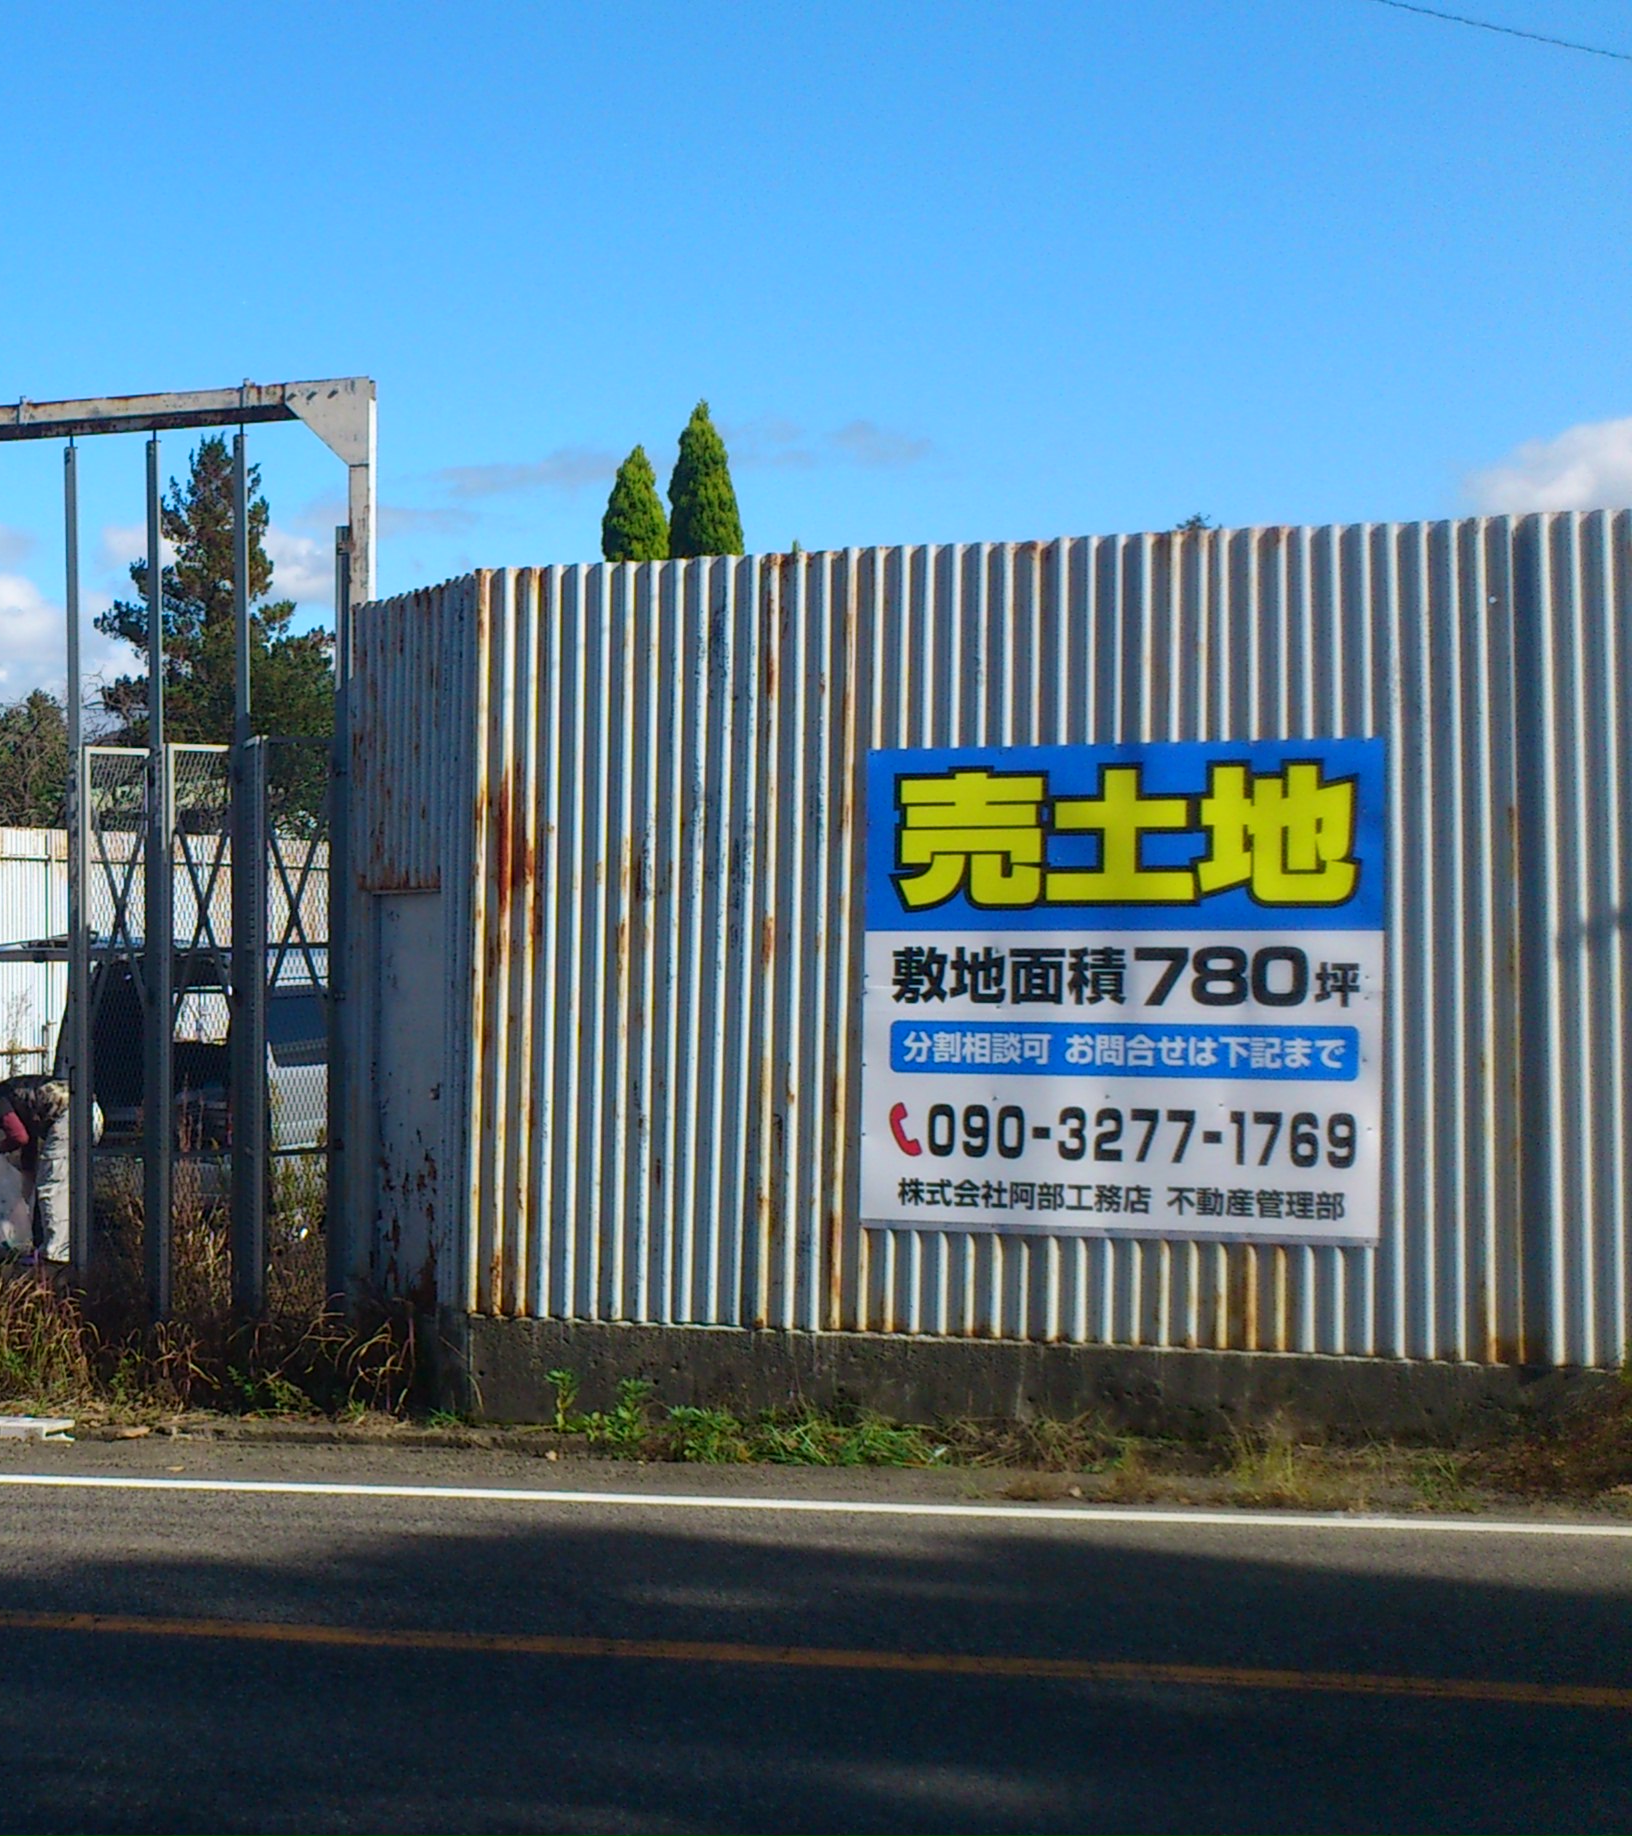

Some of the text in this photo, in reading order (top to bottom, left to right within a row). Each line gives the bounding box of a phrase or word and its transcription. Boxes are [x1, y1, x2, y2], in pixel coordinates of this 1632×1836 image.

[890, 761, 1361, 912] 売土地
[891, 945, 1361, 1008] 敷地面積780坪
[902, 1031, 1346, 1070] 分割相談可 お問合せは下記まで
[927, 1103, 1357, 1168] 090-3277-1769
[897, 1178, 1346, 1221] 株式会社阿部工務店 不動産管理部
